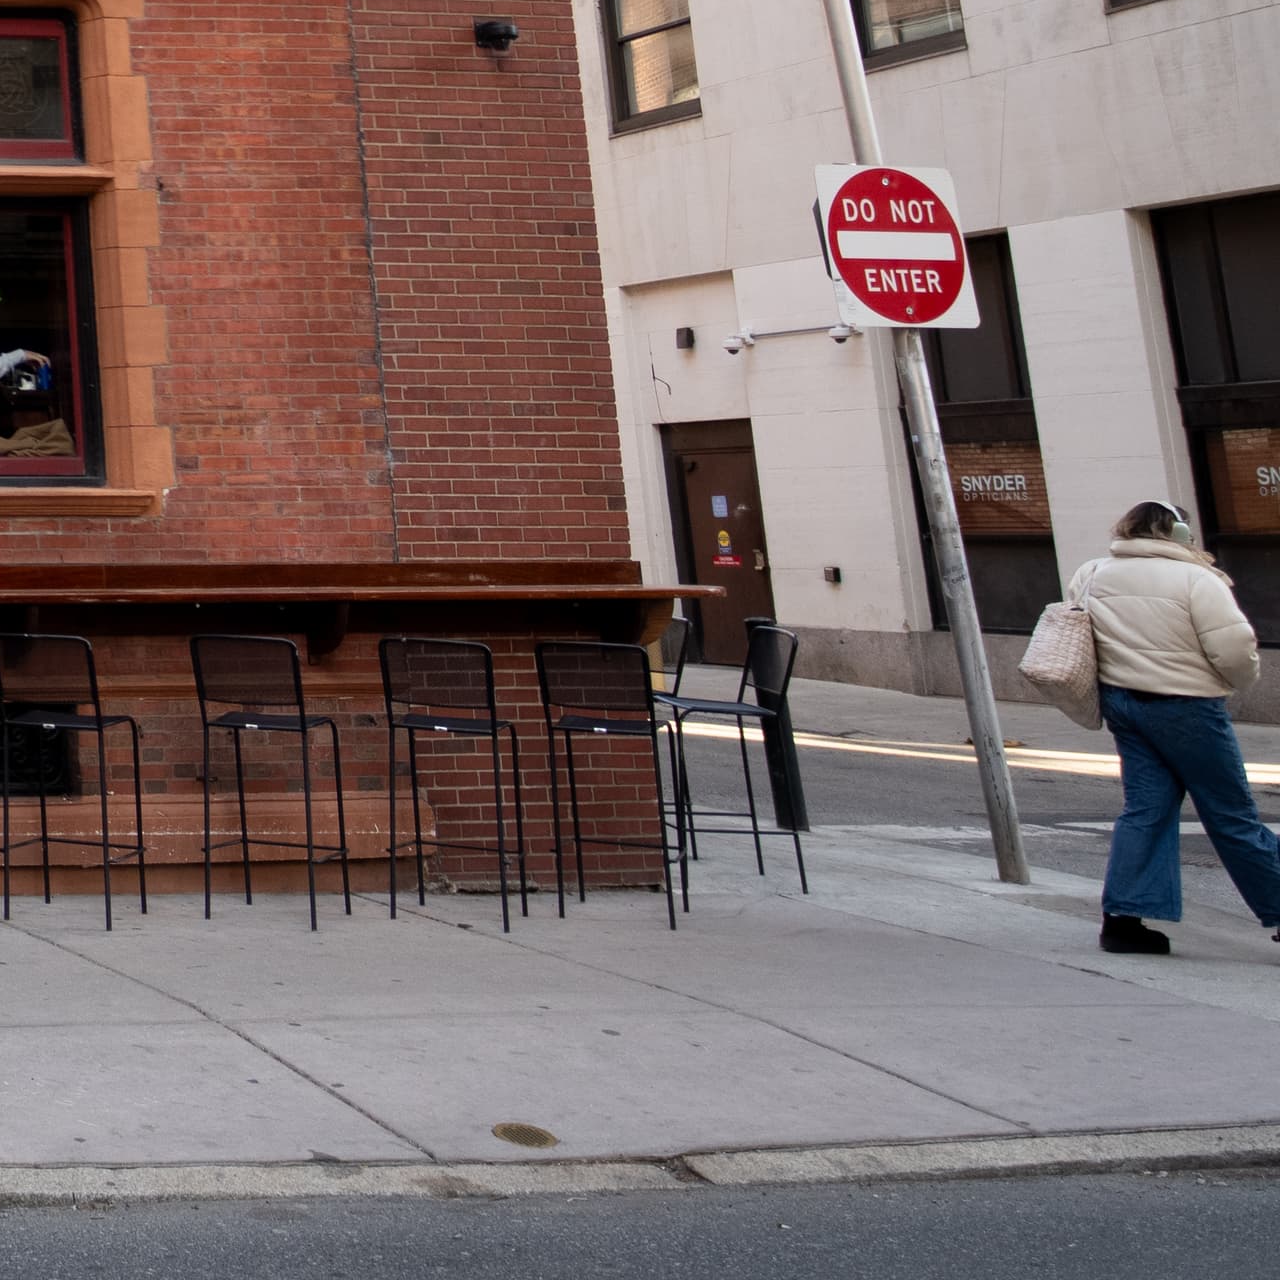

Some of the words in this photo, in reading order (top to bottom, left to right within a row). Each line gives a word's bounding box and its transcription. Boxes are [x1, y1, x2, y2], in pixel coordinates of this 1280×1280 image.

[842, 198, 876, 223] DO
[889, 199, 935, 224] NOT
[864, 268, 944, 293] ENTER
[961, 474, 1027, 492] SNYDER
[963, 491, 1028, 502] OPTICIANS
